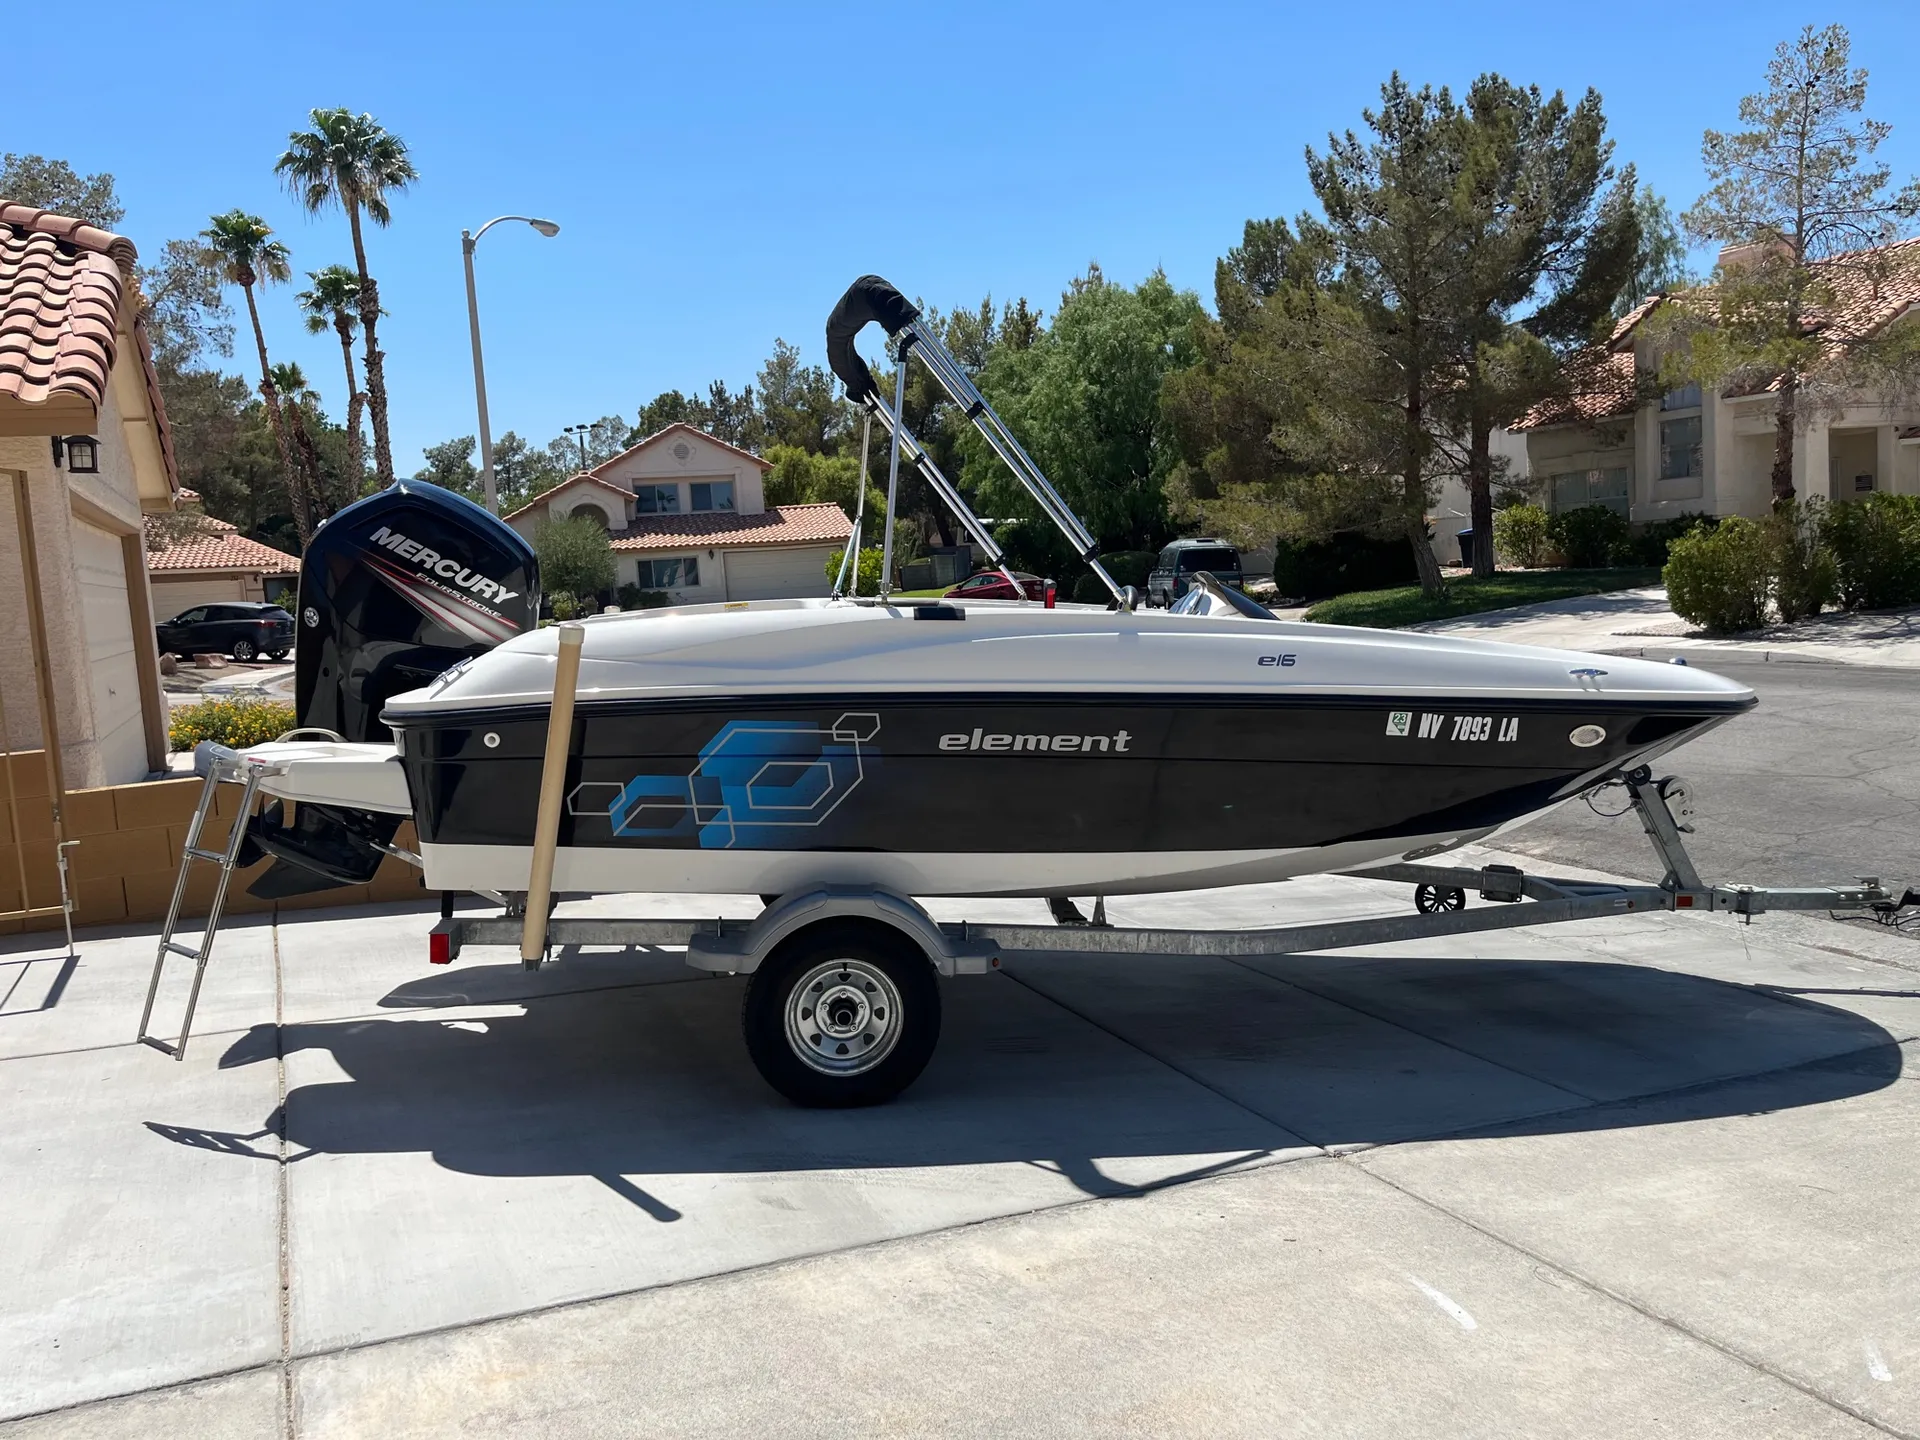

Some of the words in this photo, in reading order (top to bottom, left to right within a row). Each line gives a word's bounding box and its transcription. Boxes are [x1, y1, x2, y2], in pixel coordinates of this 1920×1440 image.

[369, 526, 519, 604] MERCURY
[415, 572, 503, 618] FOURSTROKE
[1393, 713, 1407, 723] 23
[1417, 712, 1445, 739] NV
[1450, 716, 1493, 741] 7893
[1497, 717, 1519, 742] LA
[938, 728, 1133, 752] element
